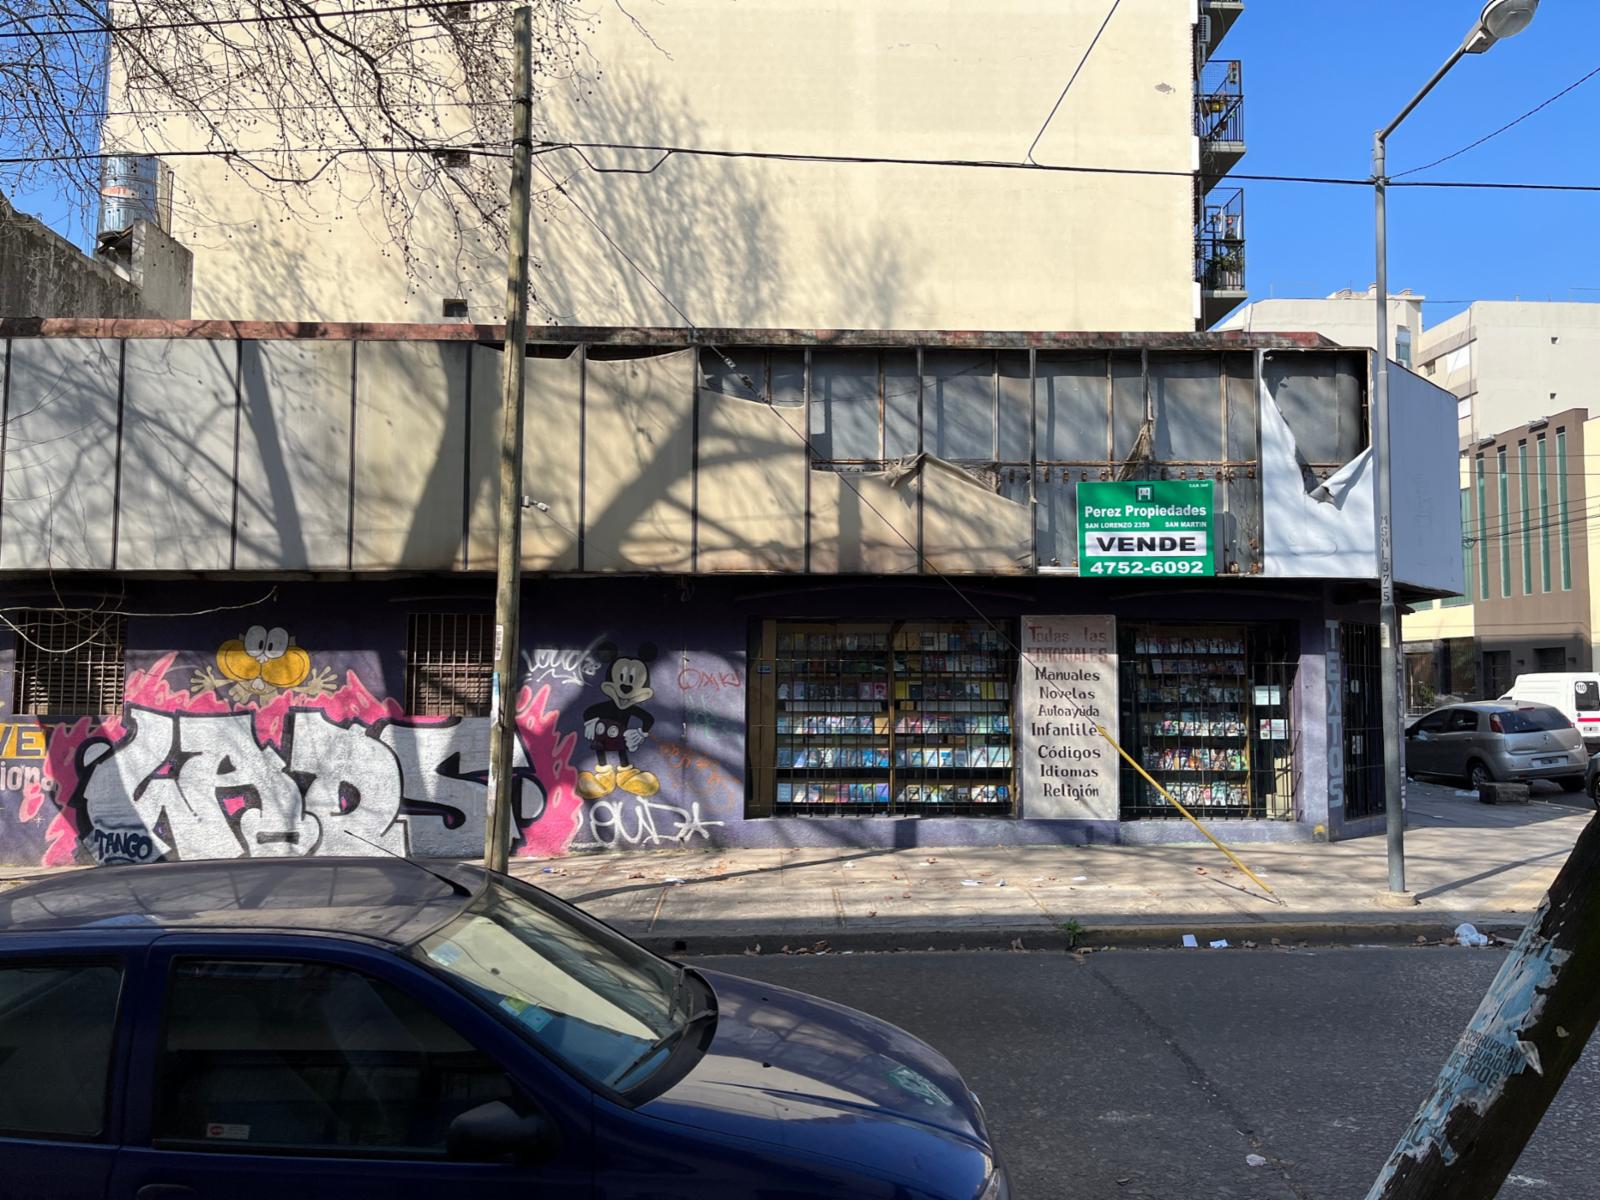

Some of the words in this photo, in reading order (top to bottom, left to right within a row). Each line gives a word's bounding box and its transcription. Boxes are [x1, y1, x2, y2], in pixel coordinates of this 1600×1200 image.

[1084, 506, 1121, 518] Perez
[1125, 504, 1206, 519] Propiedades
[1096, 537, 1196, 552] VENDE
[1090, 561, 1203, 574] 4752-6092
[1028, 625, 1070, 642] Todas
[1084, 626, 1106, 642] las
[1035, 666, 1100, 681] Manuales
[1039, 686, 1095, 700] Novelas
[1038, 704, 1100, 719] Autoayuda
[1325, 619, 1344, 809] TEXTOS
[1038, 745, 1101, 761] Códigos
[1041, 764, 1098, 778] Idiomas
[1043, 783, 1099, 800] Religión
[95, 829, 152, 860] TANGO
